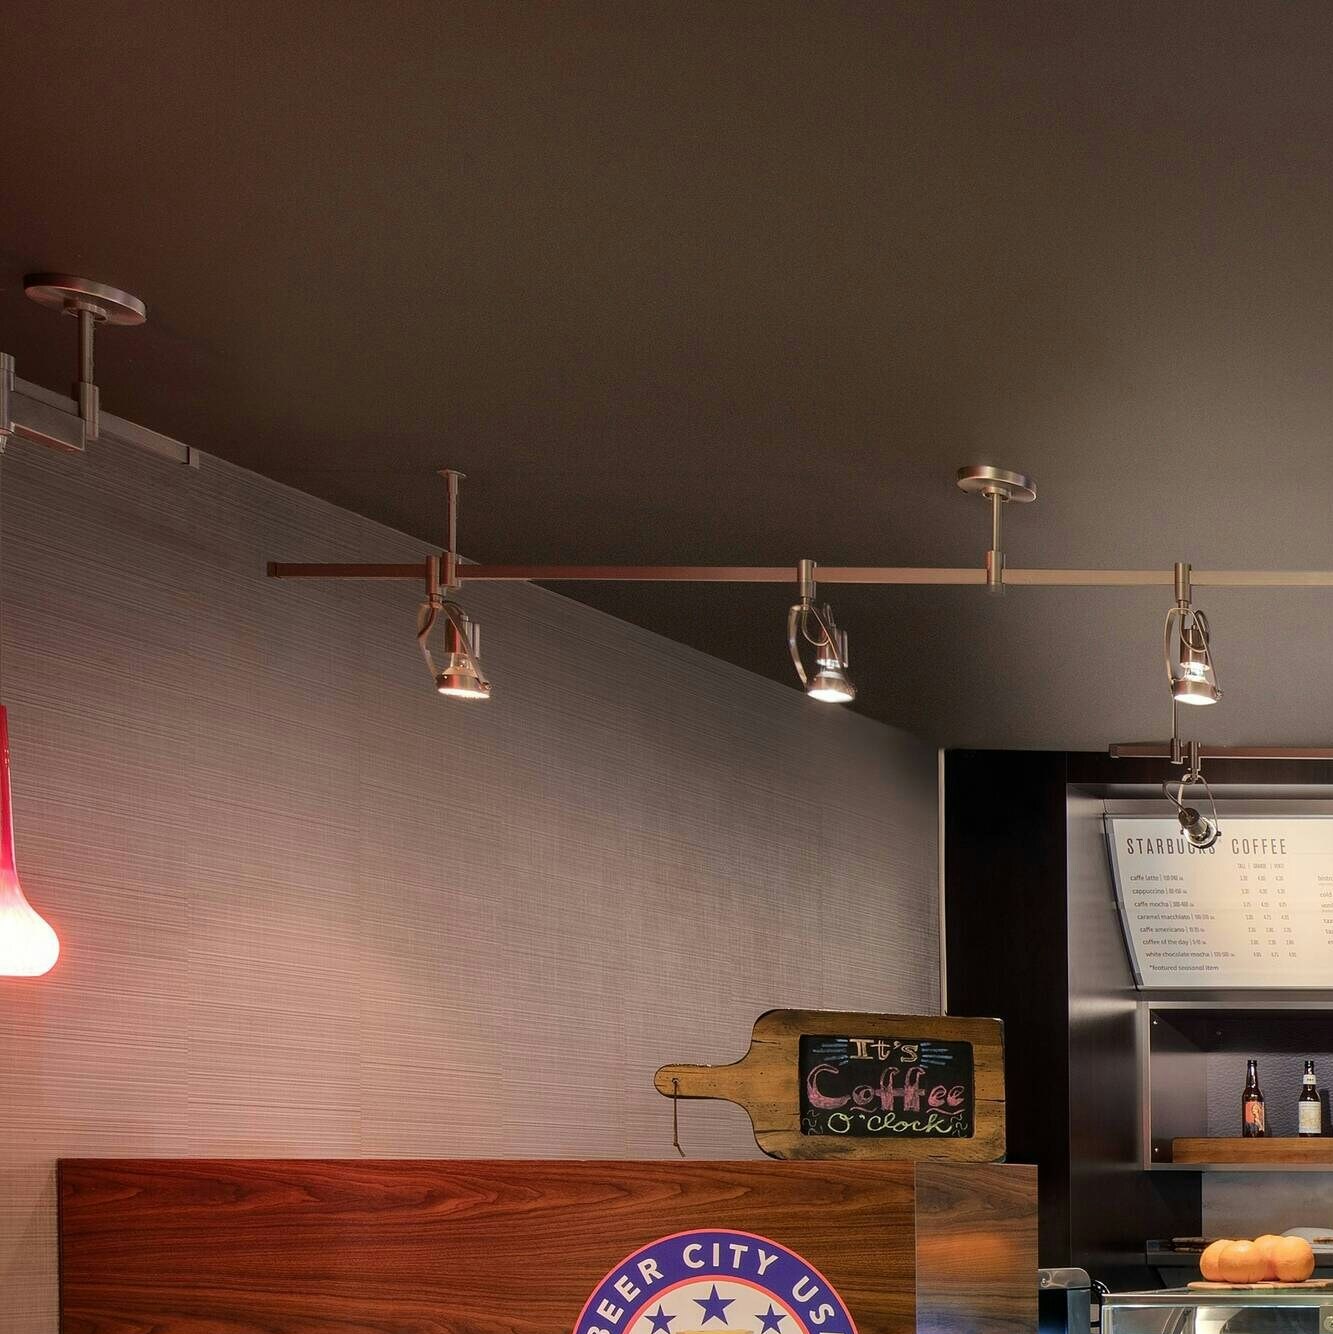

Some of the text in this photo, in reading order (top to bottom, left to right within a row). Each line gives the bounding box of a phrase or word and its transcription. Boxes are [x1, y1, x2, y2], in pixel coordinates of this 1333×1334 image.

[1231, 838, 1287, 855] COFFEE
[848, 1038, 921, 1063] It's
[805, 1062, 966, 1112] Coffee
[682, 1242, 780, 1276] CITY
